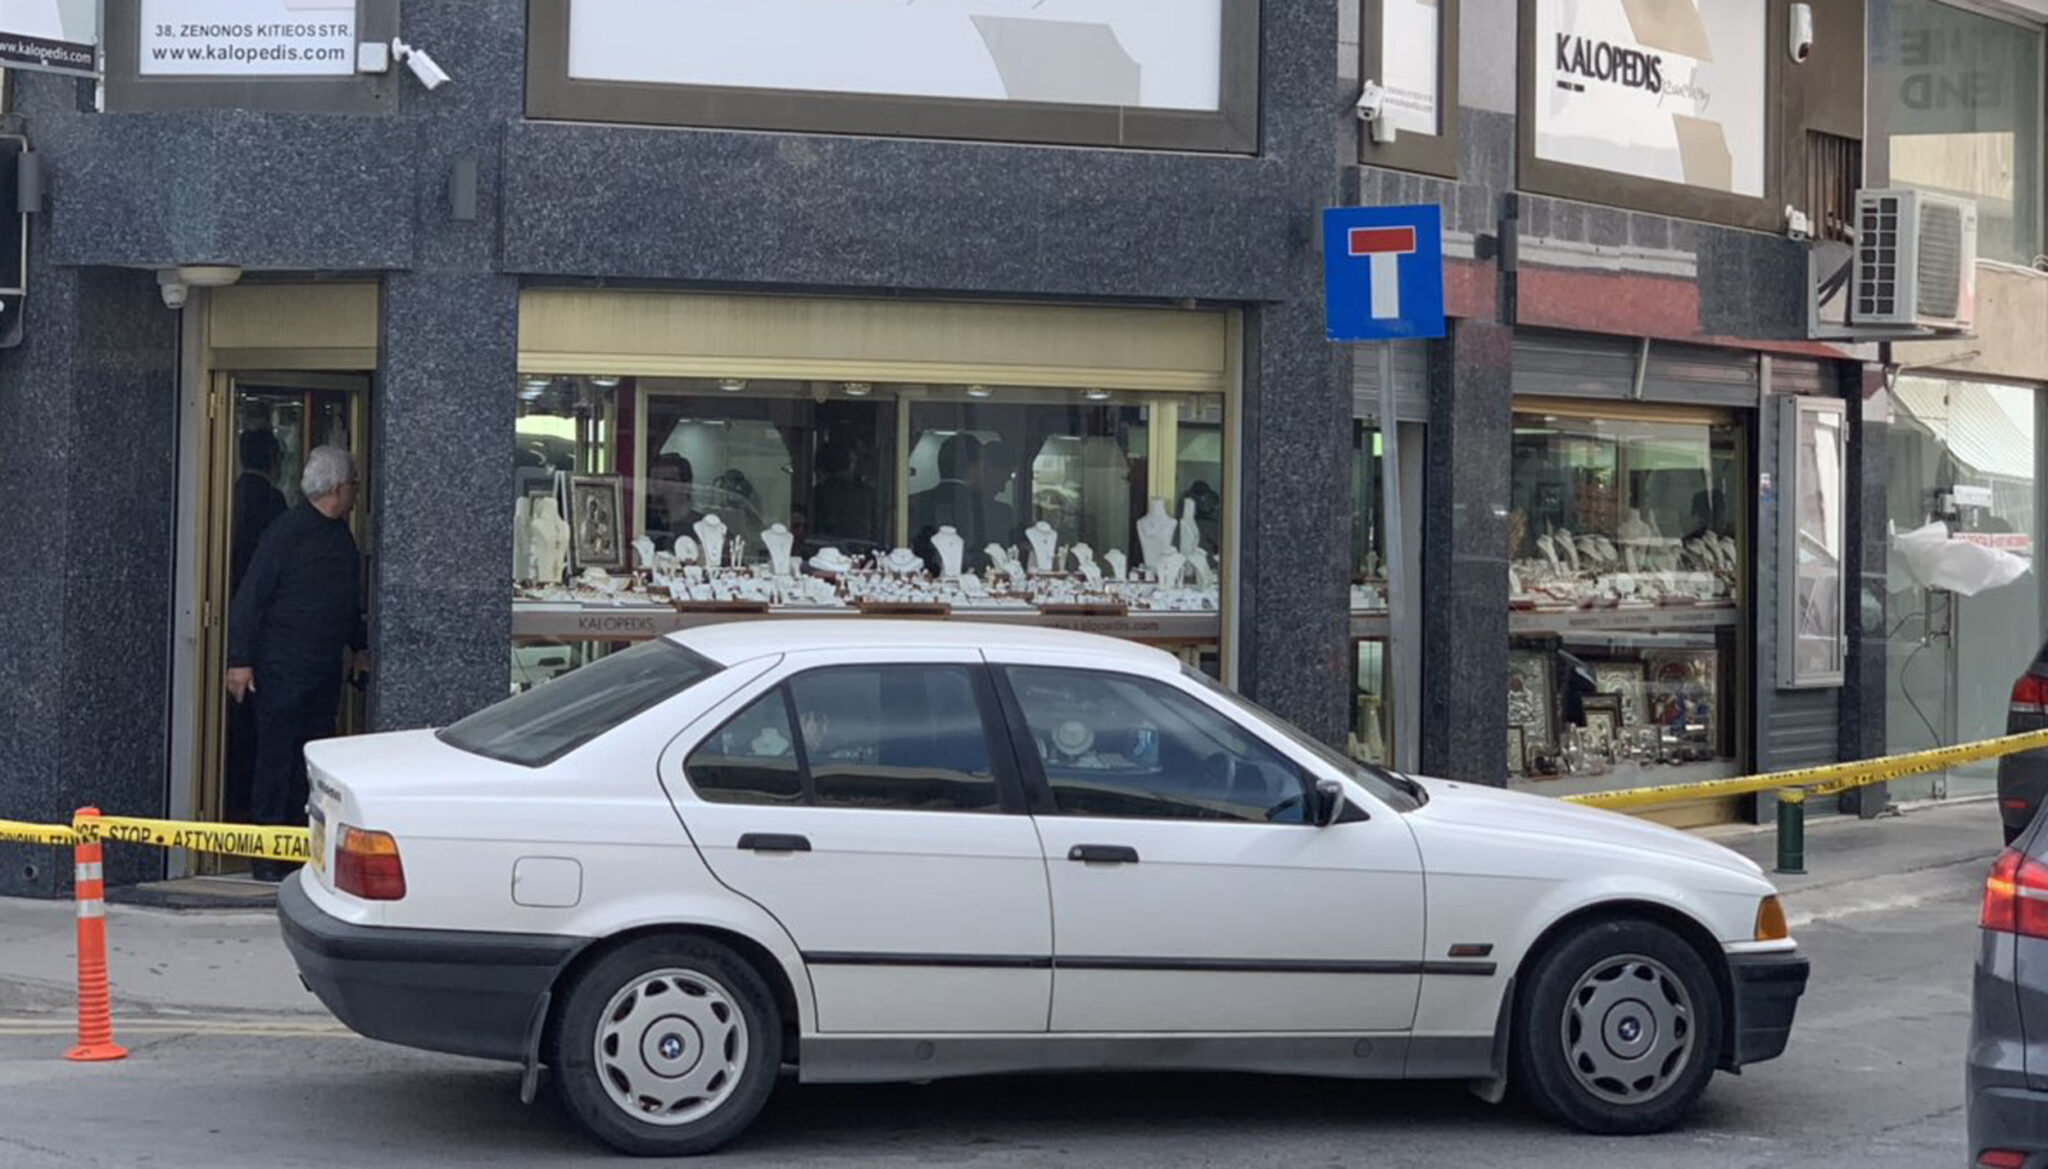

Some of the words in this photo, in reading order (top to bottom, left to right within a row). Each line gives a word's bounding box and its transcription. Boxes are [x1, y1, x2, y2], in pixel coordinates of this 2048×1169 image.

[155, 24, 176, 38] 38,
[180, 24, 253, 38] ZENONOS
[257, 24, 316, 38] KITIEOS
[151, 44, 345, 64] www.kalopedis.com
[1556, 32, 1662, 94] KALOPEDIS
[578, 616, 655, 631] KALOPEDIS
[109, 825, 152, 843] STOP
[173, 830, 264, 855] ΑΣΤΥΝΟΜΙΑ
